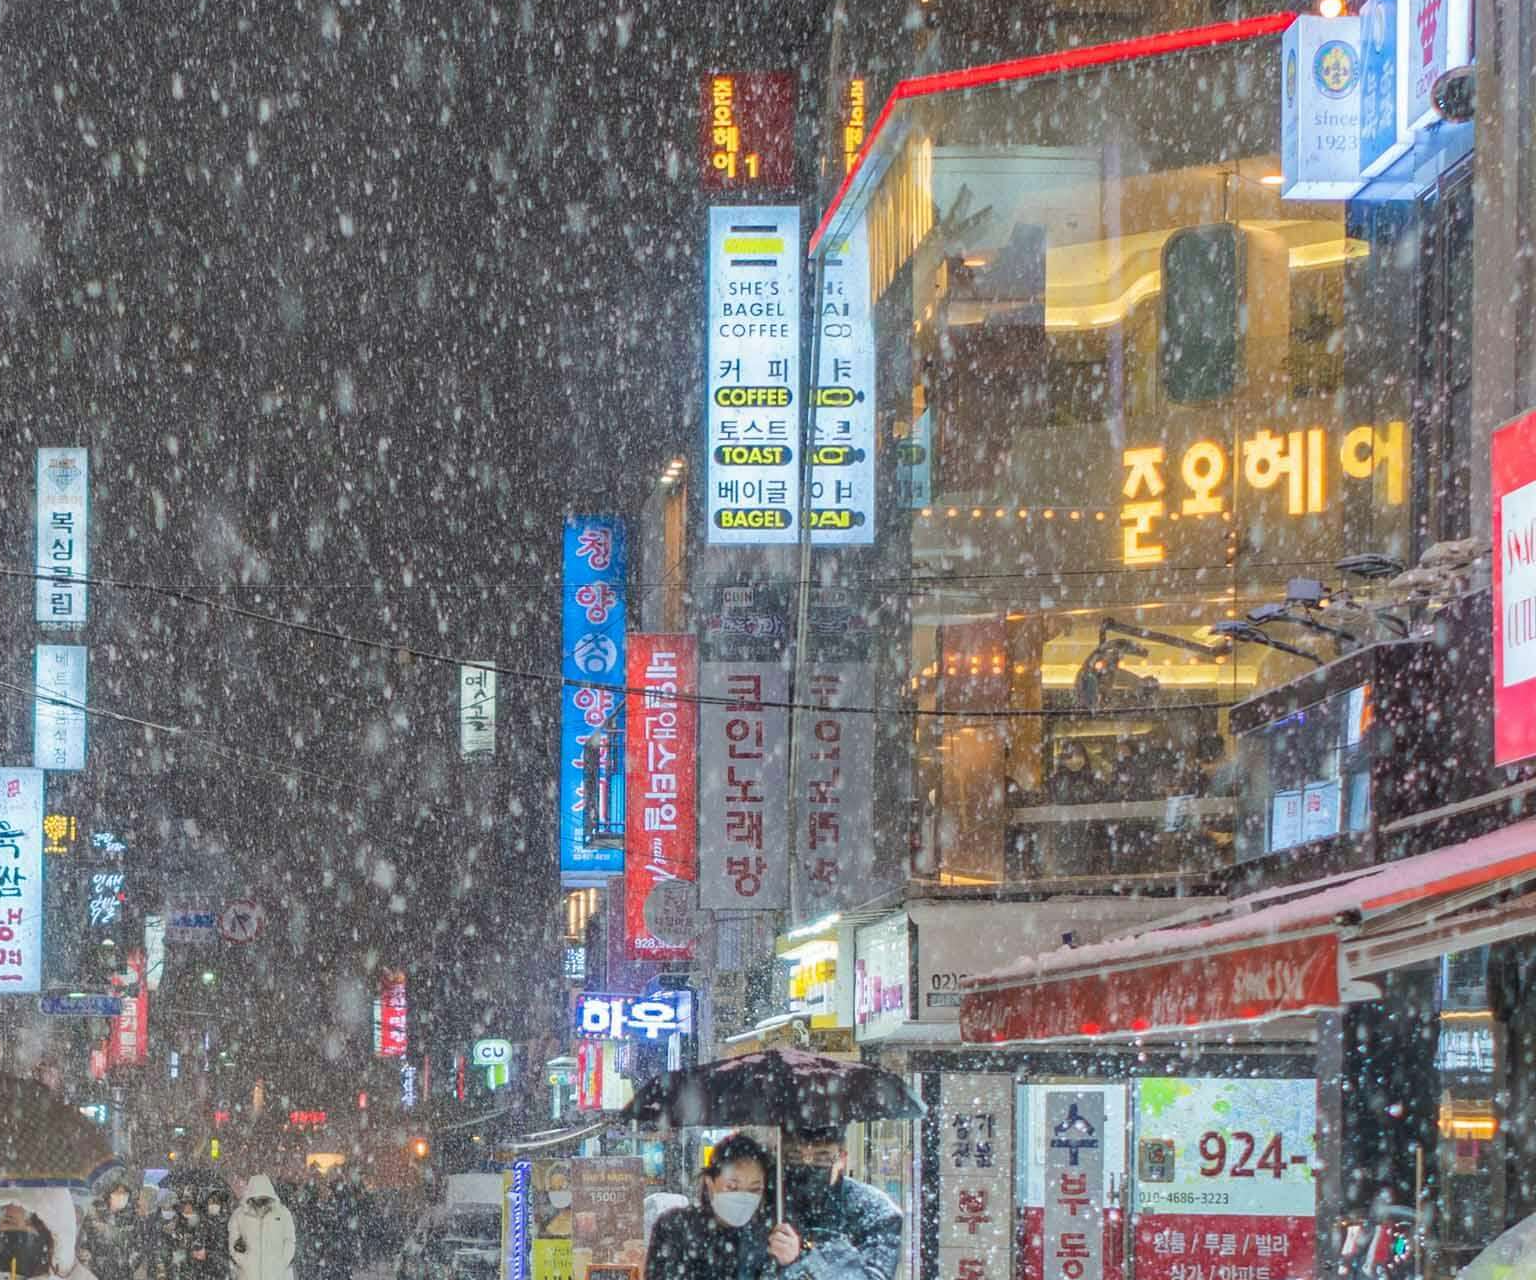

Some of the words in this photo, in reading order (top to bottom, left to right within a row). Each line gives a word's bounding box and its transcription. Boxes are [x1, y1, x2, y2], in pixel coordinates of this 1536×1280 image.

[1314, 110, 1359, 126] since
[1315, 134, 1359, 151] 1923
[728, 280, 780, 296] SHE'S
[722, 302, 784, 317] BAGEL
[719, 324, 789, 338] COFFEE
[716, 388, 790, 406] COFFEE
[718, 419, 789, 441] 토스트
[722, 447, 782, 464] TOAST
[718, 480, 788, 504] 베이글
[721, 510, 785, 528] BAGEL
[481, 1046, 505, 1059] CU
[1204, 1234, 1237, 1256] 투룸
[1255, 1234, 1290, 1256] 빌라
